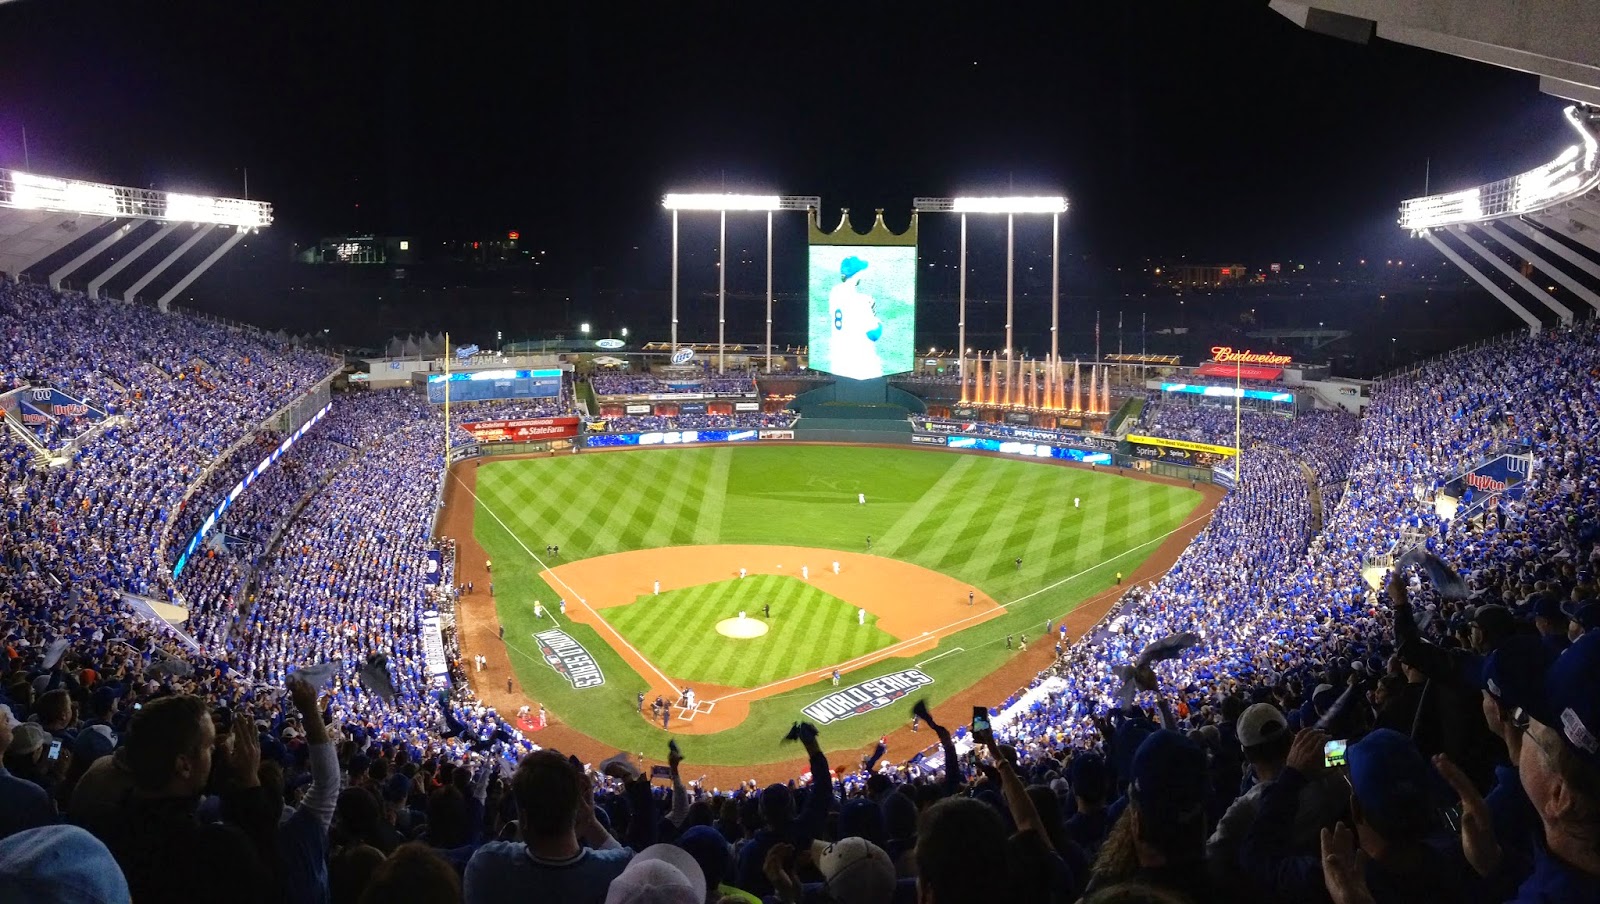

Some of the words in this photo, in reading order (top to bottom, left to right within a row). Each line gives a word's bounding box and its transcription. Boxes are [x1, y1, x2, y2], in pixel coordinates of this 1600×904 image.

[834, 308, 843, 331] 8
[472, 355, 498, 366] FAME
[675, 351, 692, 363] Lite
[1211, 346, 1292, 364] Budweiser
[389, 360, 401, 370] 42
[1136, 446, 1158, 457] Sprint
[1169, 449, 1184, 457] Sprint
[535, 629, 585, 657] WORLD
[563, 654, 603, 688] SERIES
[804, 687, 873, 724] WORLD
[861, 670, 931, 697] SERIES
